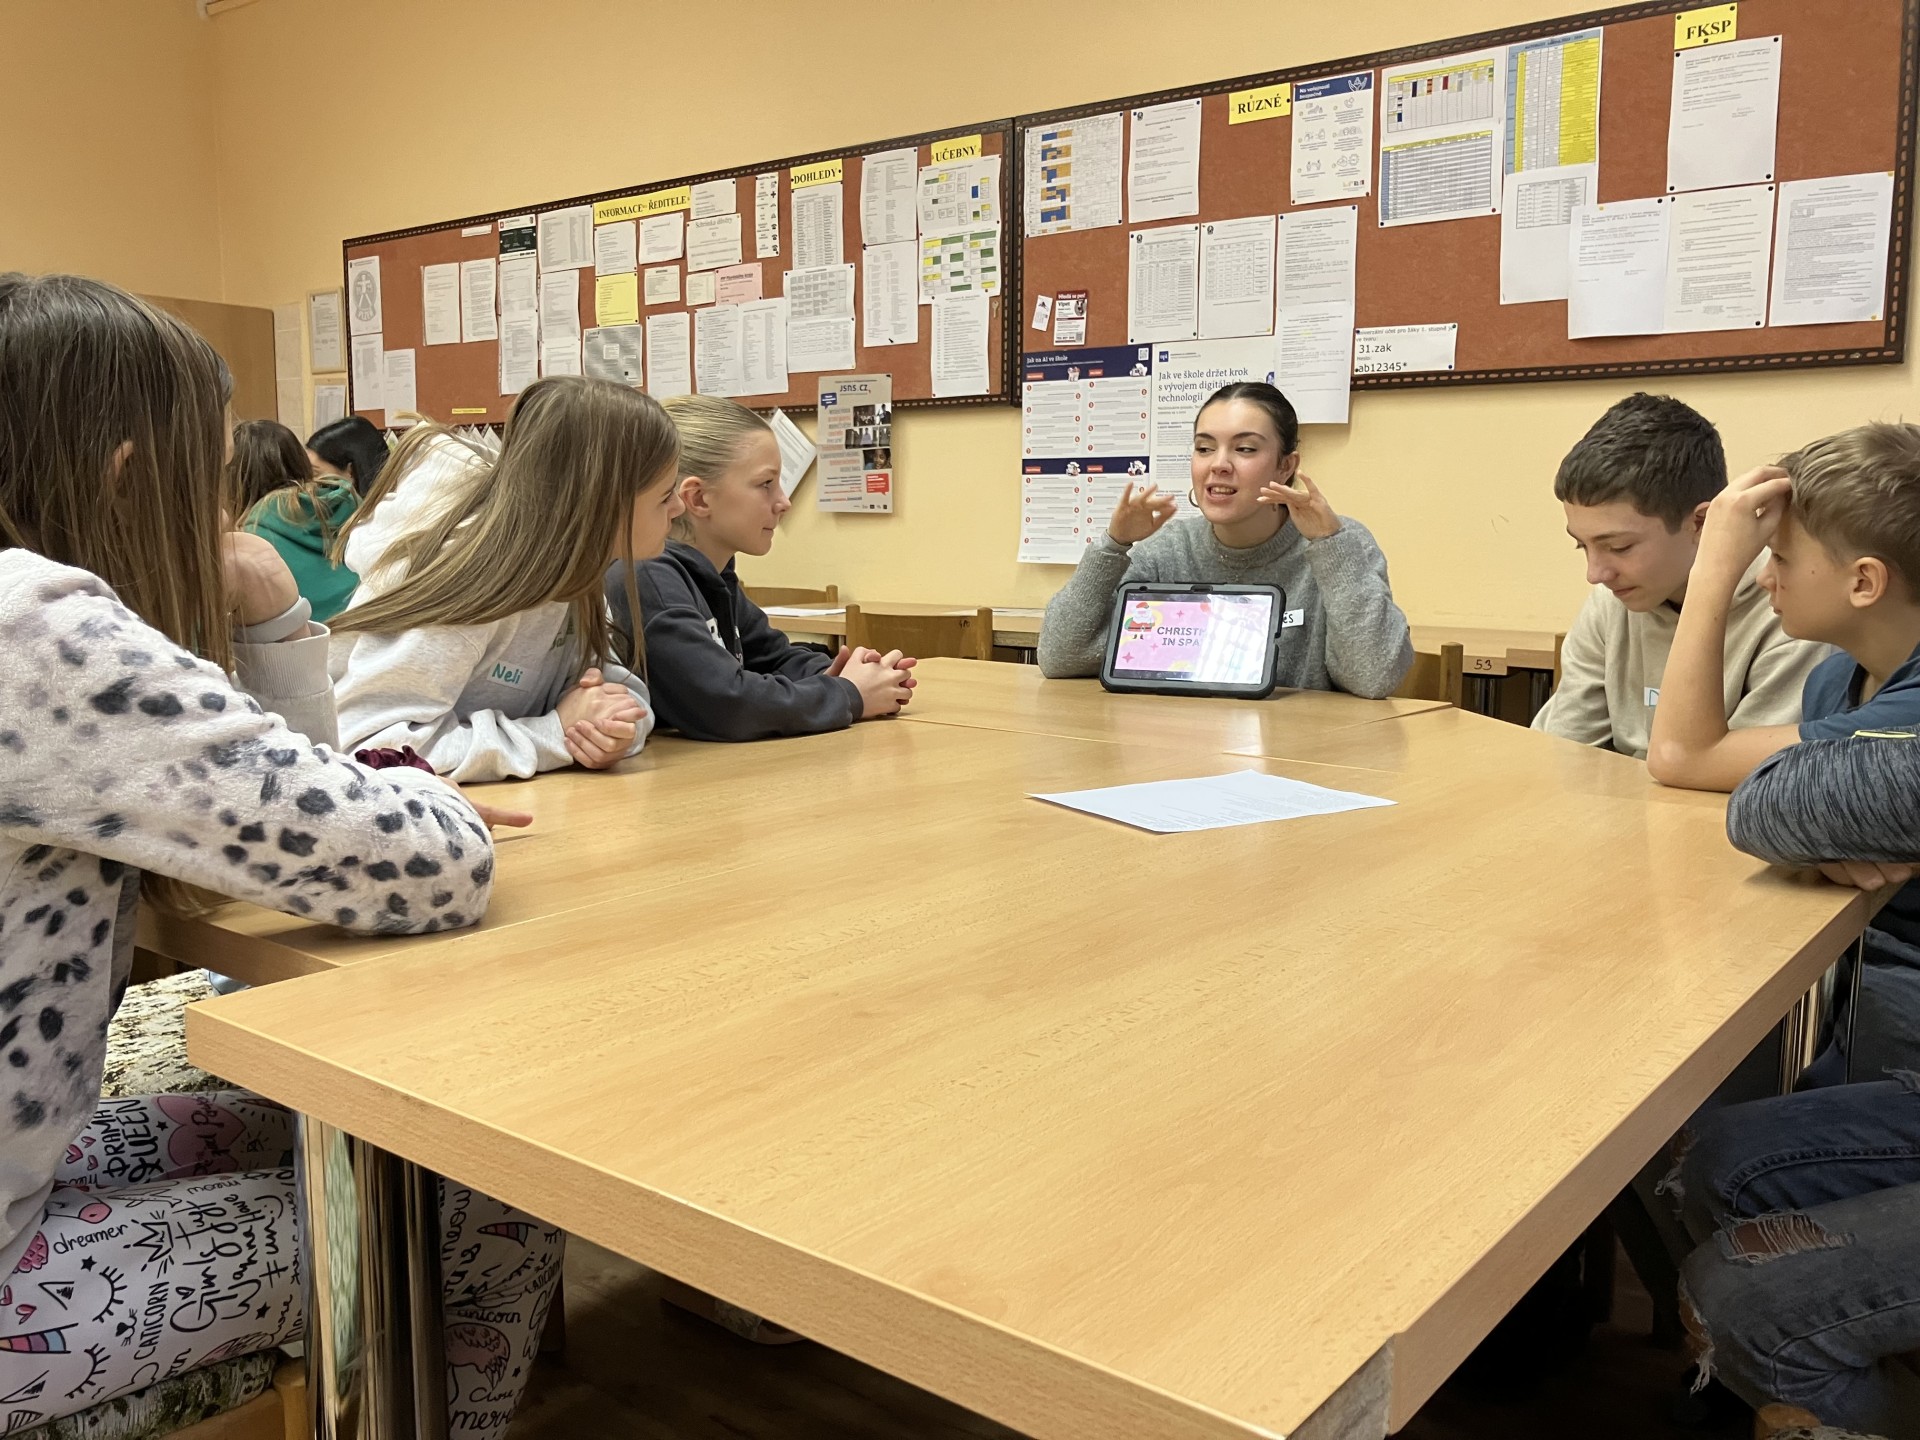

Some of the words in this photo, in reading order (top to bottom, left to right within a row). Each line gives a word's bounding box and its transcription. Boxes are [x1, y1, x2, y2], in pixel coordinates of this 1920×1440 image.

[1686, 19, 1732, 40] FKSP
[1237, 93, 1282, 115] RŮZNÉ
[935, 145, 977, 162] UČEBNY
[793, 168, 837, 184] DOHLEDY
[599, 203, 643, 219] INFORMACE
[648, 195, 687, 211] ŘEDITELE
[1359, 343, 1392, 354] 31.zak
[1159, 371, 1171, 381] Jak
[1183, 370, 1204, 379] škole
[1206, 368, 1227, 378] držet
[1229, 367, 1249, 376] krok
[1164, 383, 1198, 392] vývojem
[1158, 393, 1203, 404] technologií
[1161, 637, 1177, 646] IN
[491, 662, 523, 684] Neli
[1474, 658, 1493, 671] 53
[98, 1099, 164, 1183] QUEEN
[53, 1223, 129, 1255] dreamer
[133, 1281, 170, 1361] CATICORN
